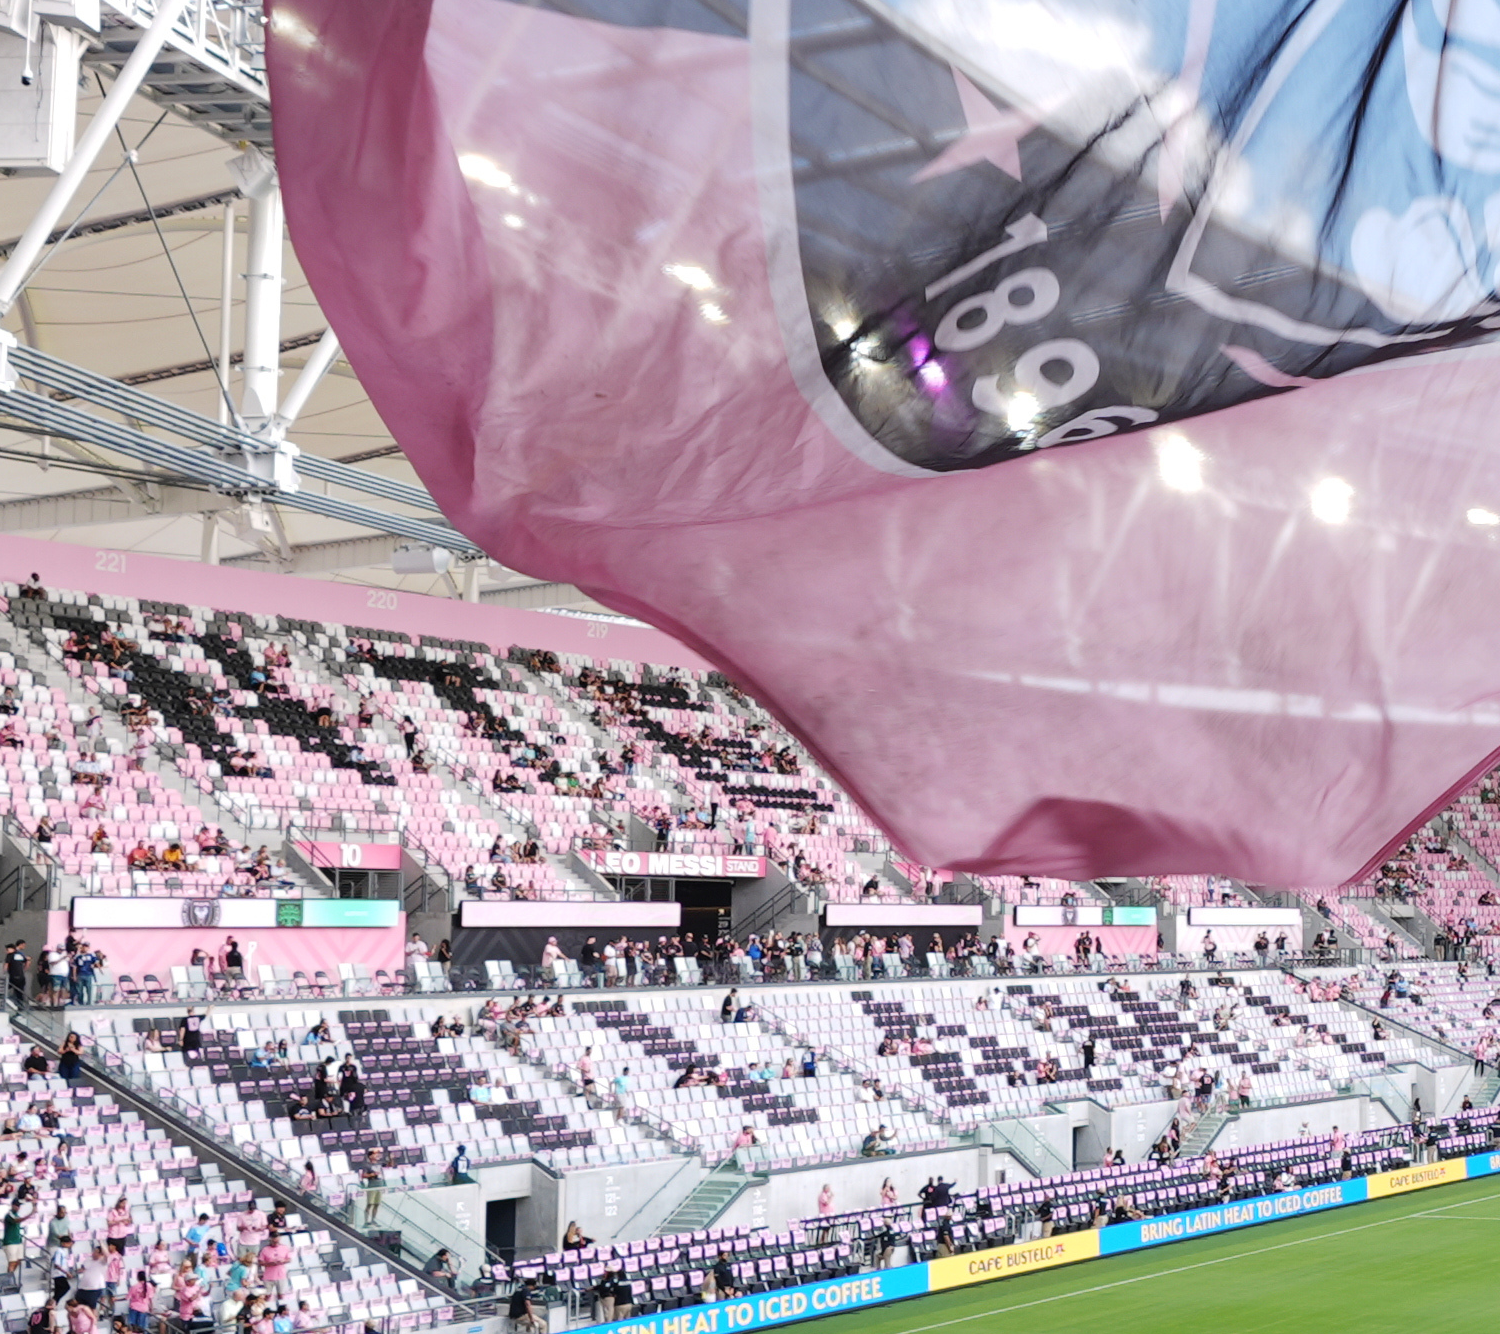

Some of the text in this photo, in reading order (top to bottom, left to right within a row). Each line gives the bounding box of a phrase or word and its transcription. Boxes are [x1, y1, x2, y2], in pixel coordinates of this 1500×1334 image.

[94, 551, 126, 574] 221
[340, 845, 361, 868] 10
[590, 851, 760, 876] LEO MESSI STAND
[1140, 1186, 1344, 1242] BRING LATIN HEAT TO ICED COFFEE
[1006, 1246, 1054, 1268] BUSTELO
[723, 1304, 753, 1334] TO
[759, 1293, 808, 1329] ICED
[814, 1275, 884, 1319] COFFEE
